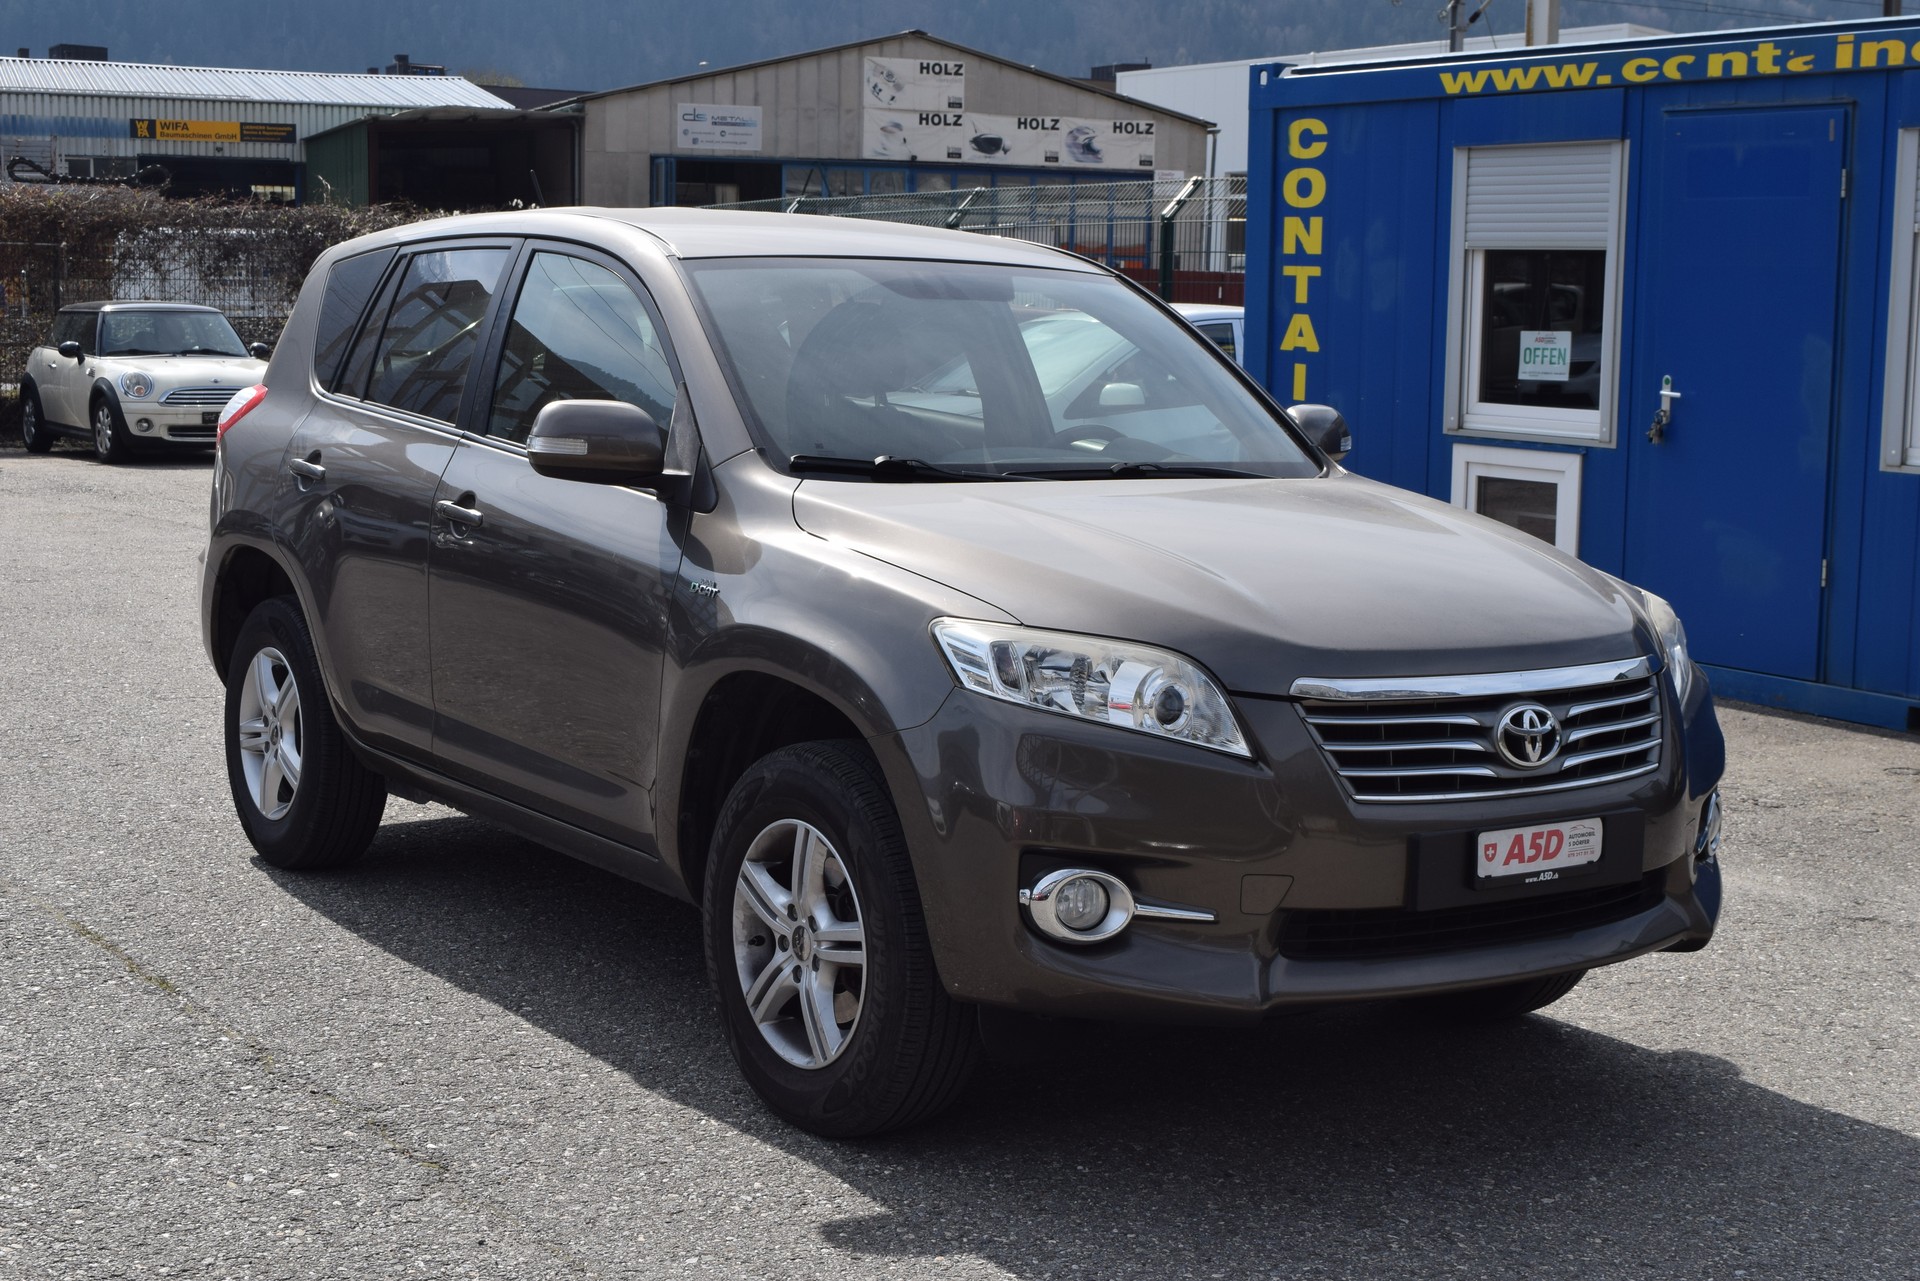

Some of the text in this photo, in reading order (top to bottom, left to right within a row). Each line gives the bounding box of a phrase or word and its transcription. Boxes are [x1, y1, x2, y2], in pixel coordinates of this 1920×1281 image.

[919, 61, 964, 76] HOLZ
[159, 121, 190, 131] WIFA
[918, 112, 963, 127] HOLZ
[1017, 117, 1060, 131] HOLZ
[1112, 121, 1154, 135] HOLZ
[159, 131, 212, 140] Baumaschinen
[214, 132, 238, 141] GmbH
[1523, 346, 1567, 366] OFFEN
[1503, 829, 1564, 866] A5D
